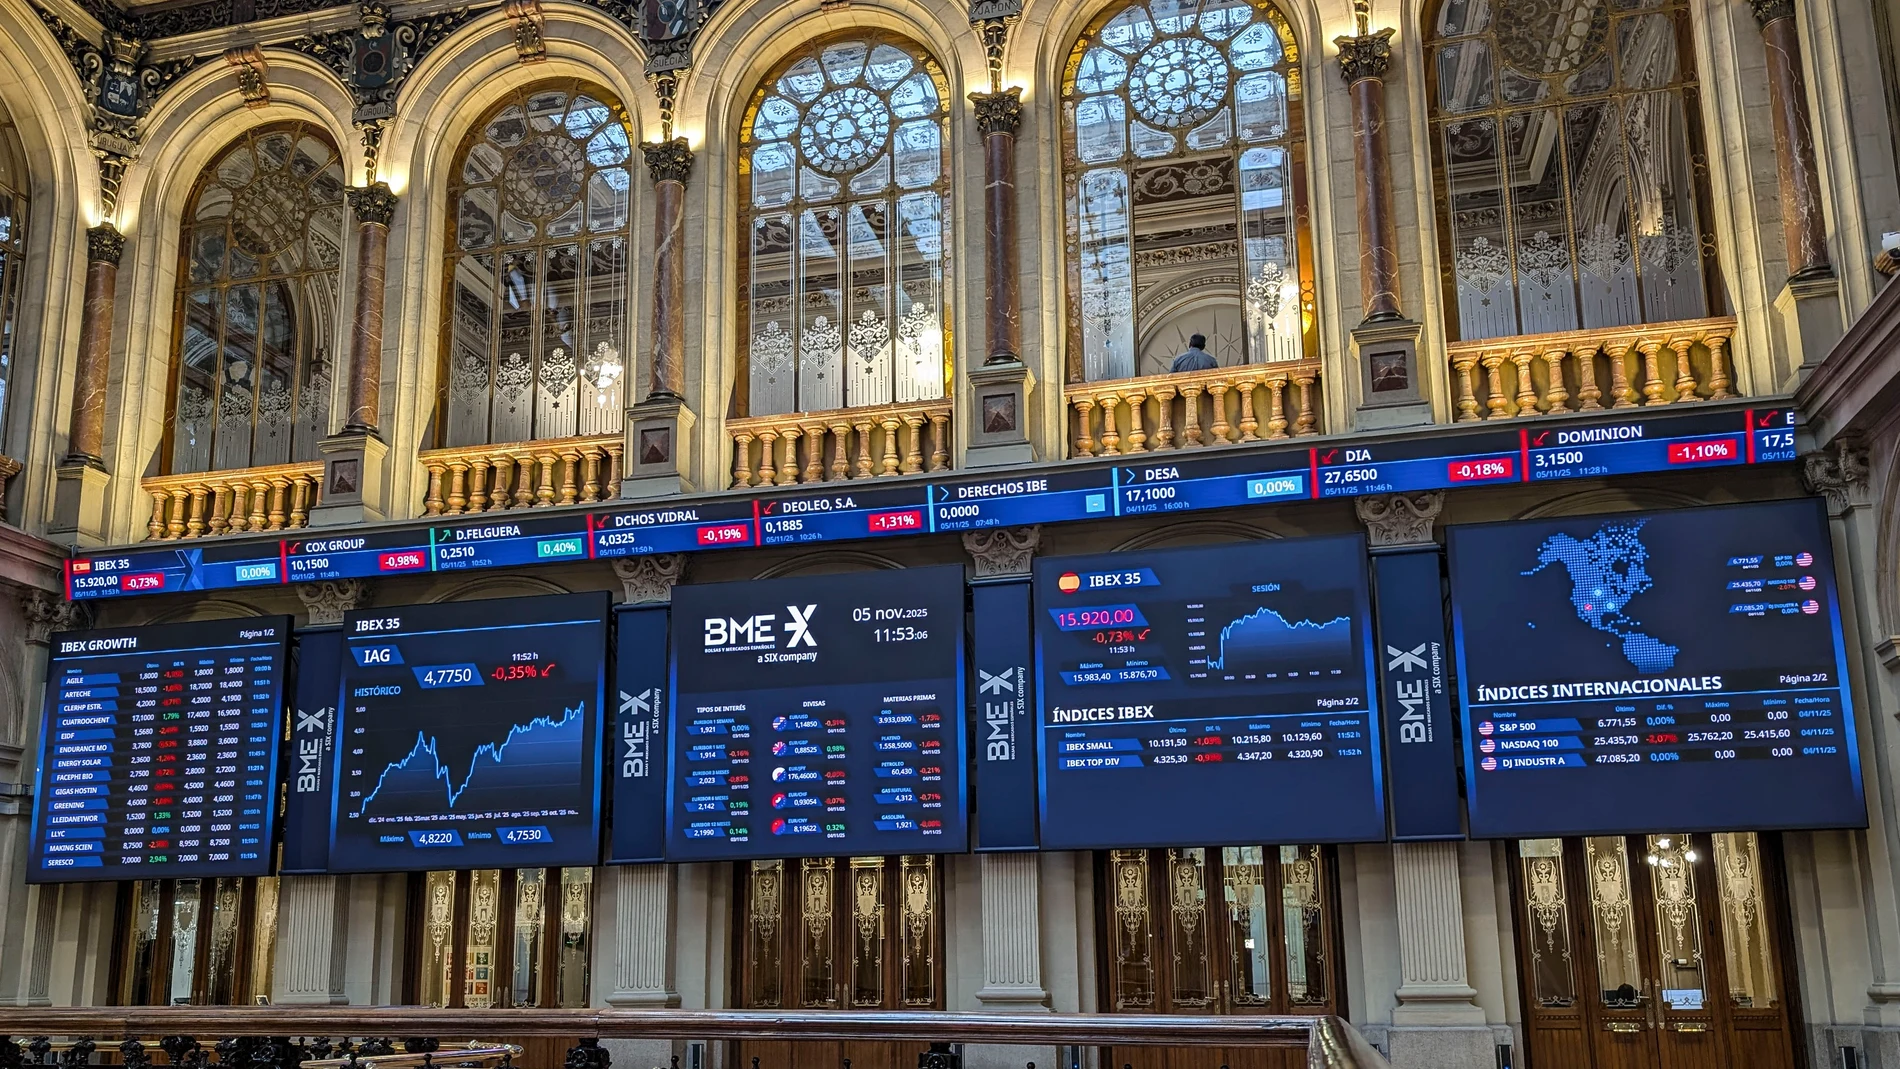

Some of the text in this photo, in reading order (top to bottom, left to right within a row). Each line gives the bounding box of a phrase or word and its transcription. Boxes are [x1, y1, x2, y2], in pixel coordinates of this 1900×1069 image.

[653, 56, 683, 68] SUECIA
[1559, 426, 1644, 446] DOMINION
[1346, 449, 1371, 462] DIA
[1536, 443, 1729, 467] 3,1500 -1,10%
[1146, 467, 1179, 480] DESA
[1325, 461, 1506, 484] 27,6500 -0,18%
[1536, 469, 1571, 478] 05/11/25
[1579, 466, 1600, 474] 11:28
[959, 480, 1047, 500] DERECHOS IBE
[1126, 477, 1297, 502] 17,1000 0,00%
[783, 497, 857, 513] DEOLEO, S.A.
[940, 505, 979, 519] 0,0000
[616, 510, 699, 526] DCHOS VIDRAL
[766, 513, 916, 533] 0,1885 -1,31%
[456, 526, 522, 542] D.FELGUERA
[599, 526, 743, 546] 4,0325 -0,19%
[306, 539, 364, 552] COX GROUP
[441, 540, 578, 559] 0,2510 0,40%
[95, 559, 129, 571] IBEX 35
[292, 552, 421, 571] 10,1500 -0,98%
[239, 565, 273, 580] 0,00%
[1090, 573, 1141, 587] IBEX 35
[75, 575, 160, 590] 15.920,00 -0,73%
[1252, 583, 1280, 592] SESIÓN
[853, 608, 870, 621] 05
[1059, 609, 1133, 626] 15.920,00
[356, 618, 400, 631] IBEX 35
[705, 614, 775, 645] BME
[240, 630, 262, 639] Página
[874, 627, 928, 642] 11:53:06
[1093, 631, 1134, 644] -0,73%
[61, 637, 136, 652] IBEX GROWTH
[364, 649, 390, 663] IAG
[512, 653, 532, 661] 11:52
[764, 653, 778, 662] SIX
[779, 652, 817, 663] company
[1432, 642, 1440, 675] company
[424, 669, 471, 685] 4,7750
[492, 665, 536, 681] -0,35%
[1074, 670, 1157, 681] 15.983,40 15.876,70
[1780, 673, 1827, 684] Página 2/2
[1433, 676, 1441, 688] SIX
[1478, 676, 1722, 701] ÍNDICES INTERNACIONALES
[355, 685, 401, 697] HISTÓRICO
[1317, 699, 1344, 708] Página
[1053, 705, 1154, 722] ÍNDICES IBEX
[1396, 680, 1426, 743] BME
[62, 717, 110, 725] CUATROOCHENT
[1520, 723, 1536, 731] 500
[1598, 718, 1636, 727] 6.771,55
[1647, 716, 1675, 726] 0,00%
[1711, 714, 1731, 723] 0,00
[1768, 711, 1788, 720] 0,00
[987, 702, 1008, 760] BME
[1501, 740, 1539, 749] NASDAQ
[1542, 739, 1558, 747] 100
[1594, 736, 1638, 745] 25.435,70
[1688, 732, 1733, 741] 25.762,20
[1744, 729, 1790, 738] 25.415,60
[1801, 728, 1834, 736] 04/11/25
[60, 745, 95, 753] ENDURANCE
[623, 721, 643, 778] BME
[1066, 733, 1322, 751] IBEX SMALL 10.131,50 10.215,80 10.129,60
[297, 739, 318, 792] BME
[1067, 759, 1085, 767] IBEX
[1154, 755, 1187, 763] 4.325,30
[1237, 752, 1272, 760] 4.347,20
[1288, 750, 1323, 758] 4.320,90
[1503, 759, 1512, 768] DJ
[1514, 758, 1556, 766] INDUSTR
[1596, 754, 1640, 763] 47.085,20
[1651, 752, 1679, 762] 0,00%
[1715, 750, 1735, 759] 0,00
[1772, 748, 1792, 757] 0,00
[52, 815, 98, 823] LLEIDANETWOR
[419, 833, 452, 844] 4,8220
[507, 830, 541, 841] 4,7530
